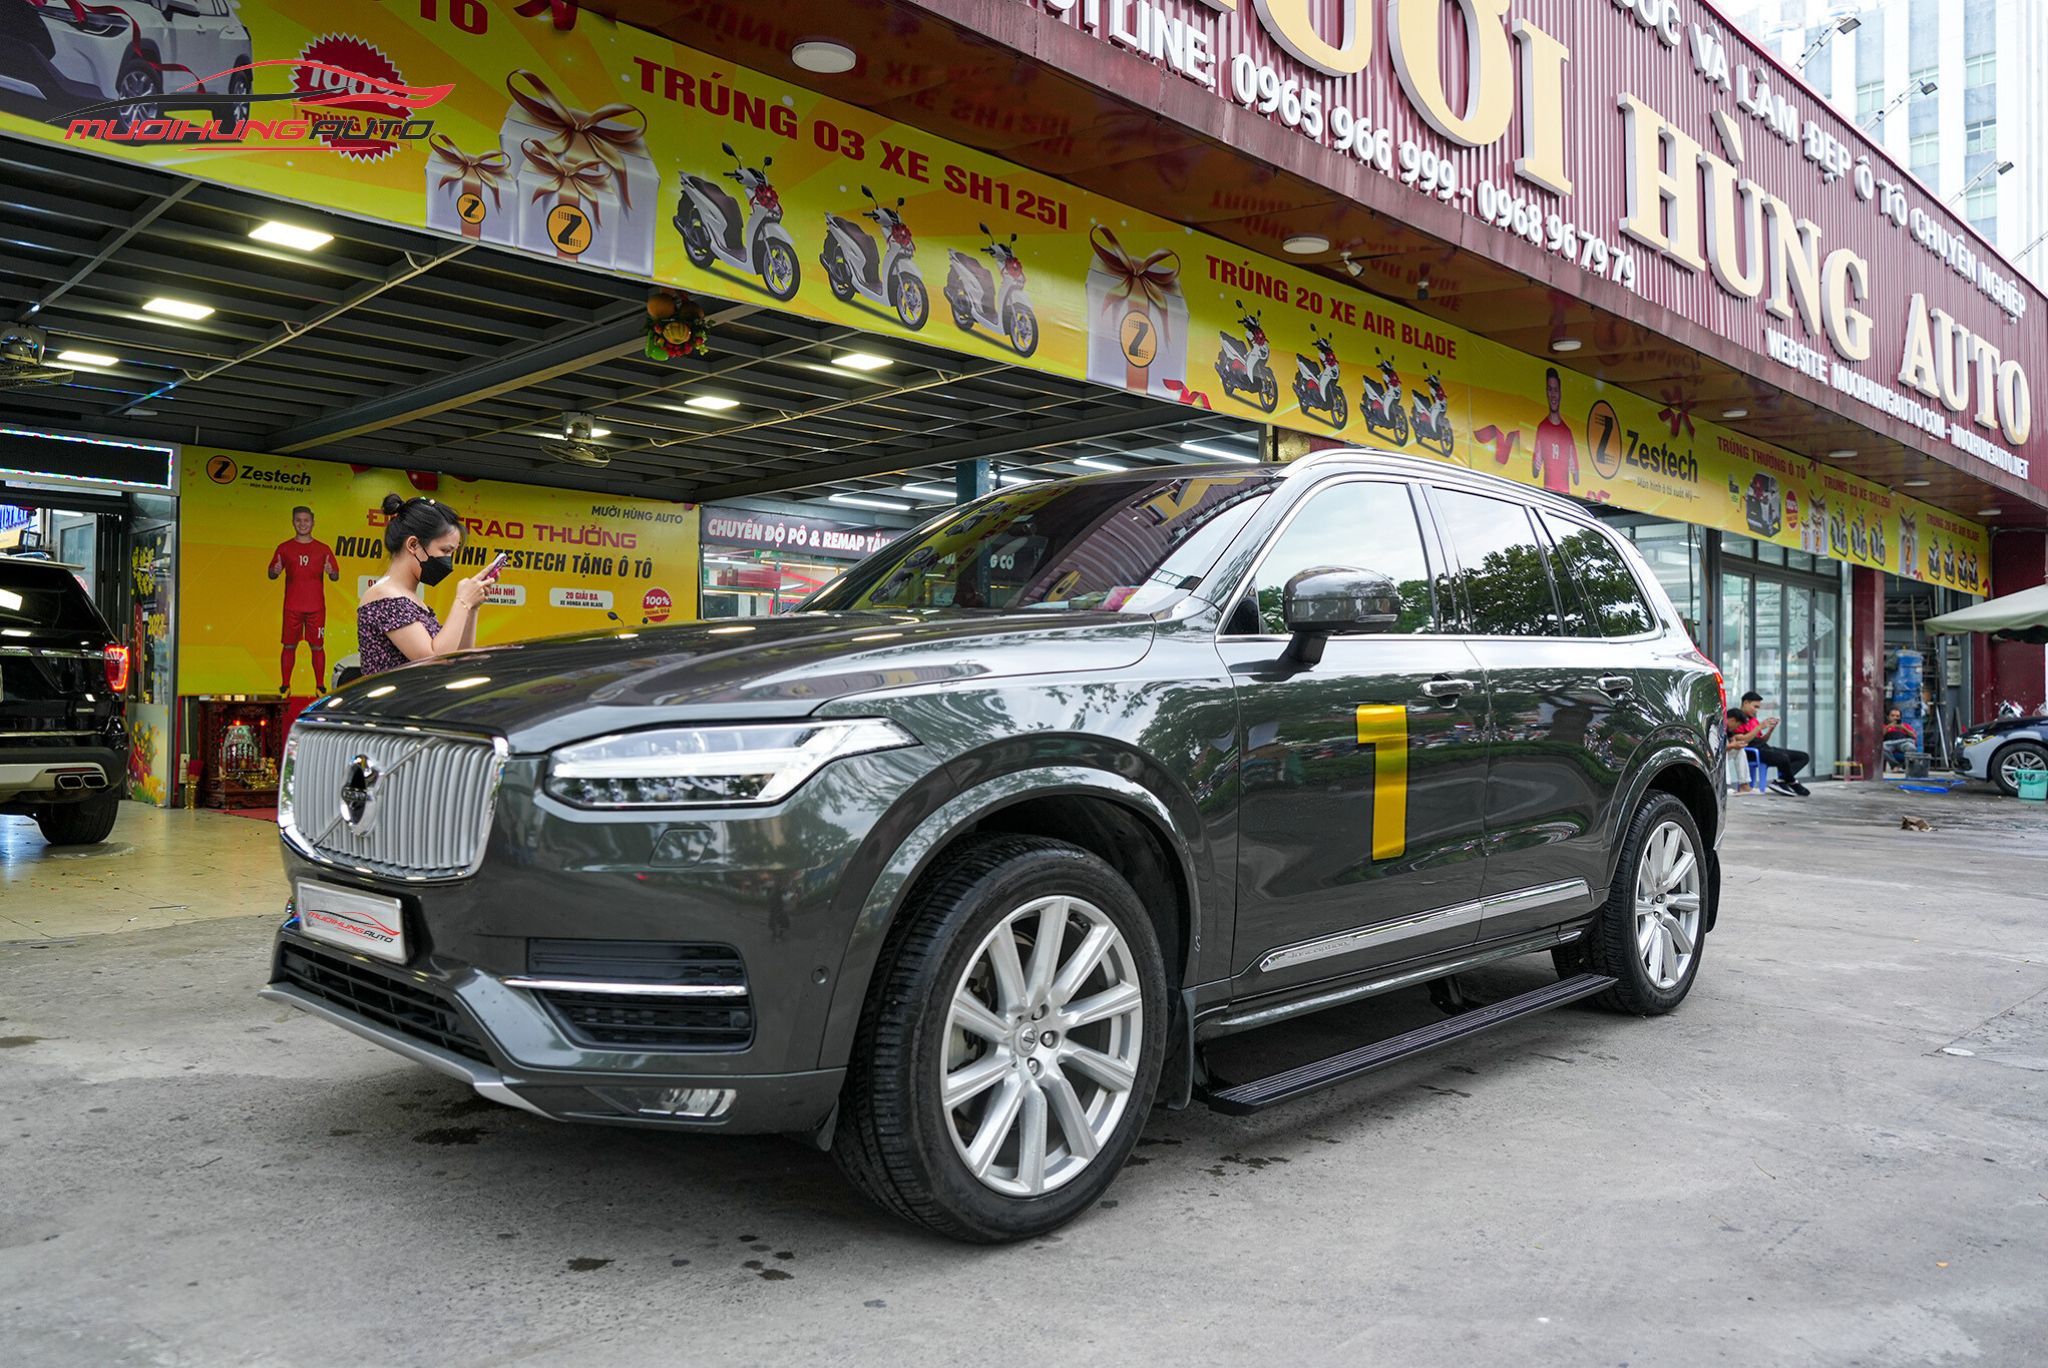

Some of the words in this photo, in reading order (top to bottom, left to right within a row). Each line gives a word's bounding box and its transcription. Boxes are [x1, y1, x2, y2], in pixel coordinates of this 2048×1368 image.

[633, 57, 798, 140] TRÚNG
[813, 120, 865, 161] 03
[880, 140, 930, 184] XE
[944, 165, 1068, 231] SH125I
[1231, 53, 1324, 138] 0965
[1331, 106, 1392, 171] 966
[1400, 141, 1455, 200] 999
[1478, 180, 1543, 244] 0968
[1546, 214, 1577, 260] 96
[1578, 229, 1608, 274] 79
[1610, 247, 1636, 289] 79
[1687, 21, 1731, 92] VÀ
[1736, 64, 1798, 145] LÀM
[1802, 120, 1851, 184] ĐẸP
[1855, 155, 1874, 200] Ô
[1876, 178, 1908, 227] TÔ
[1910, 207, 1977, 283] CHUYÊN
[1978, 261, 2026, 325] NGHIỆP
[1617, 92, 1873, 361] HÙNG
[1898, 293, 2031, 445] AUTO
[1206, 254, 1289, 304] TRÚNG
[1295, 285, 1323, 315] 20
[1330, 298, 1357, 326] XE
[1363, 311, 1395, 340] AIR
[1402, 322, 1457, 360] BLADE
[1765, 327, 1829, 385] WEBSITE
[240, 465, 311, 485] Zestech
[1625, 429, 1698, 484] Zestech
[533, 522, 637, 549] THƯỞNG
[591, 505, 620, 519] MƯỜI
[623, 506, 653, 521] HÙNG
[655, 512, 684, 525] AUTO
[708, 518, 763, 541] CHUYÊN
[764, 522, 786, 548] ĐỘ
[788, 524, 808, 546] PÔ
[809, 530, 820, 547] &
[822, 531, 865, 552] REMAP
[299, 555, 309, 566] 19
[335, 535, 383, 559] MUA
[572, 552, 613, 579] TẶNG
[618, 555, 629, 577] Ô
[634, 557, 653, 579] TÔ
[645, 595, 671, 606] 100%
